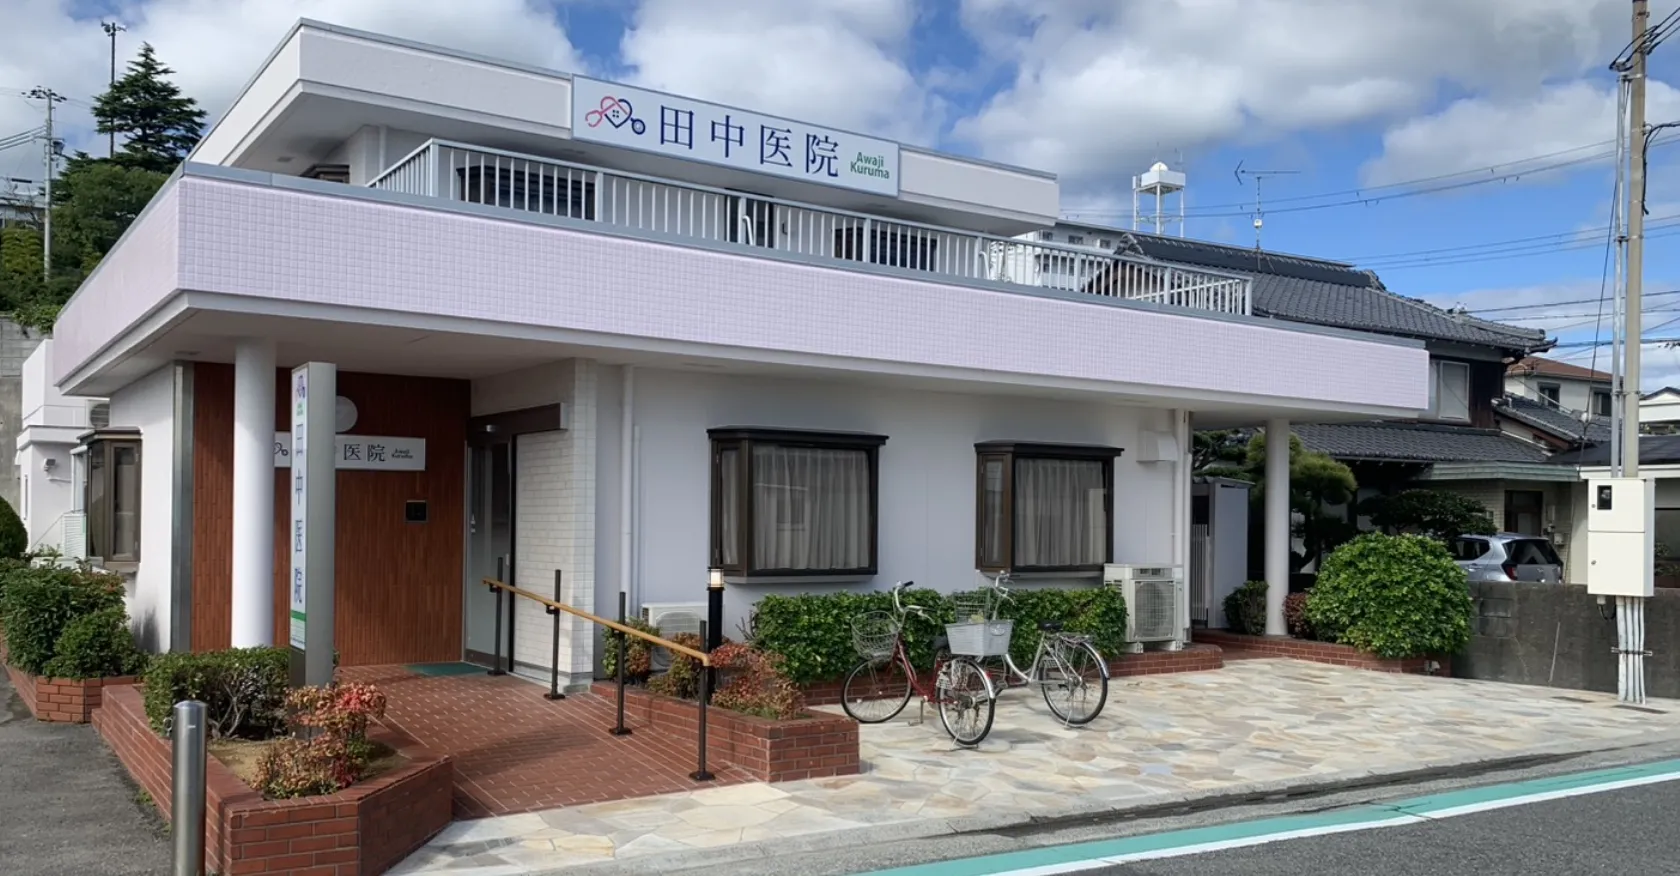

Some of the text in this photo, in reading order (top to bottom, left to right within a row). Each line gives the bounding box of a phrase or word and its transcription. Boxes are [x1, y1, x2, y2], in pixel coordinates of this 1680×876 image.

[660, 105, 839, 178] 田中医院
[856, 152, 884, 168] Awaji
[850, 161, 890, 179] Kuruma
[336, 443, 386, 463] 医院
